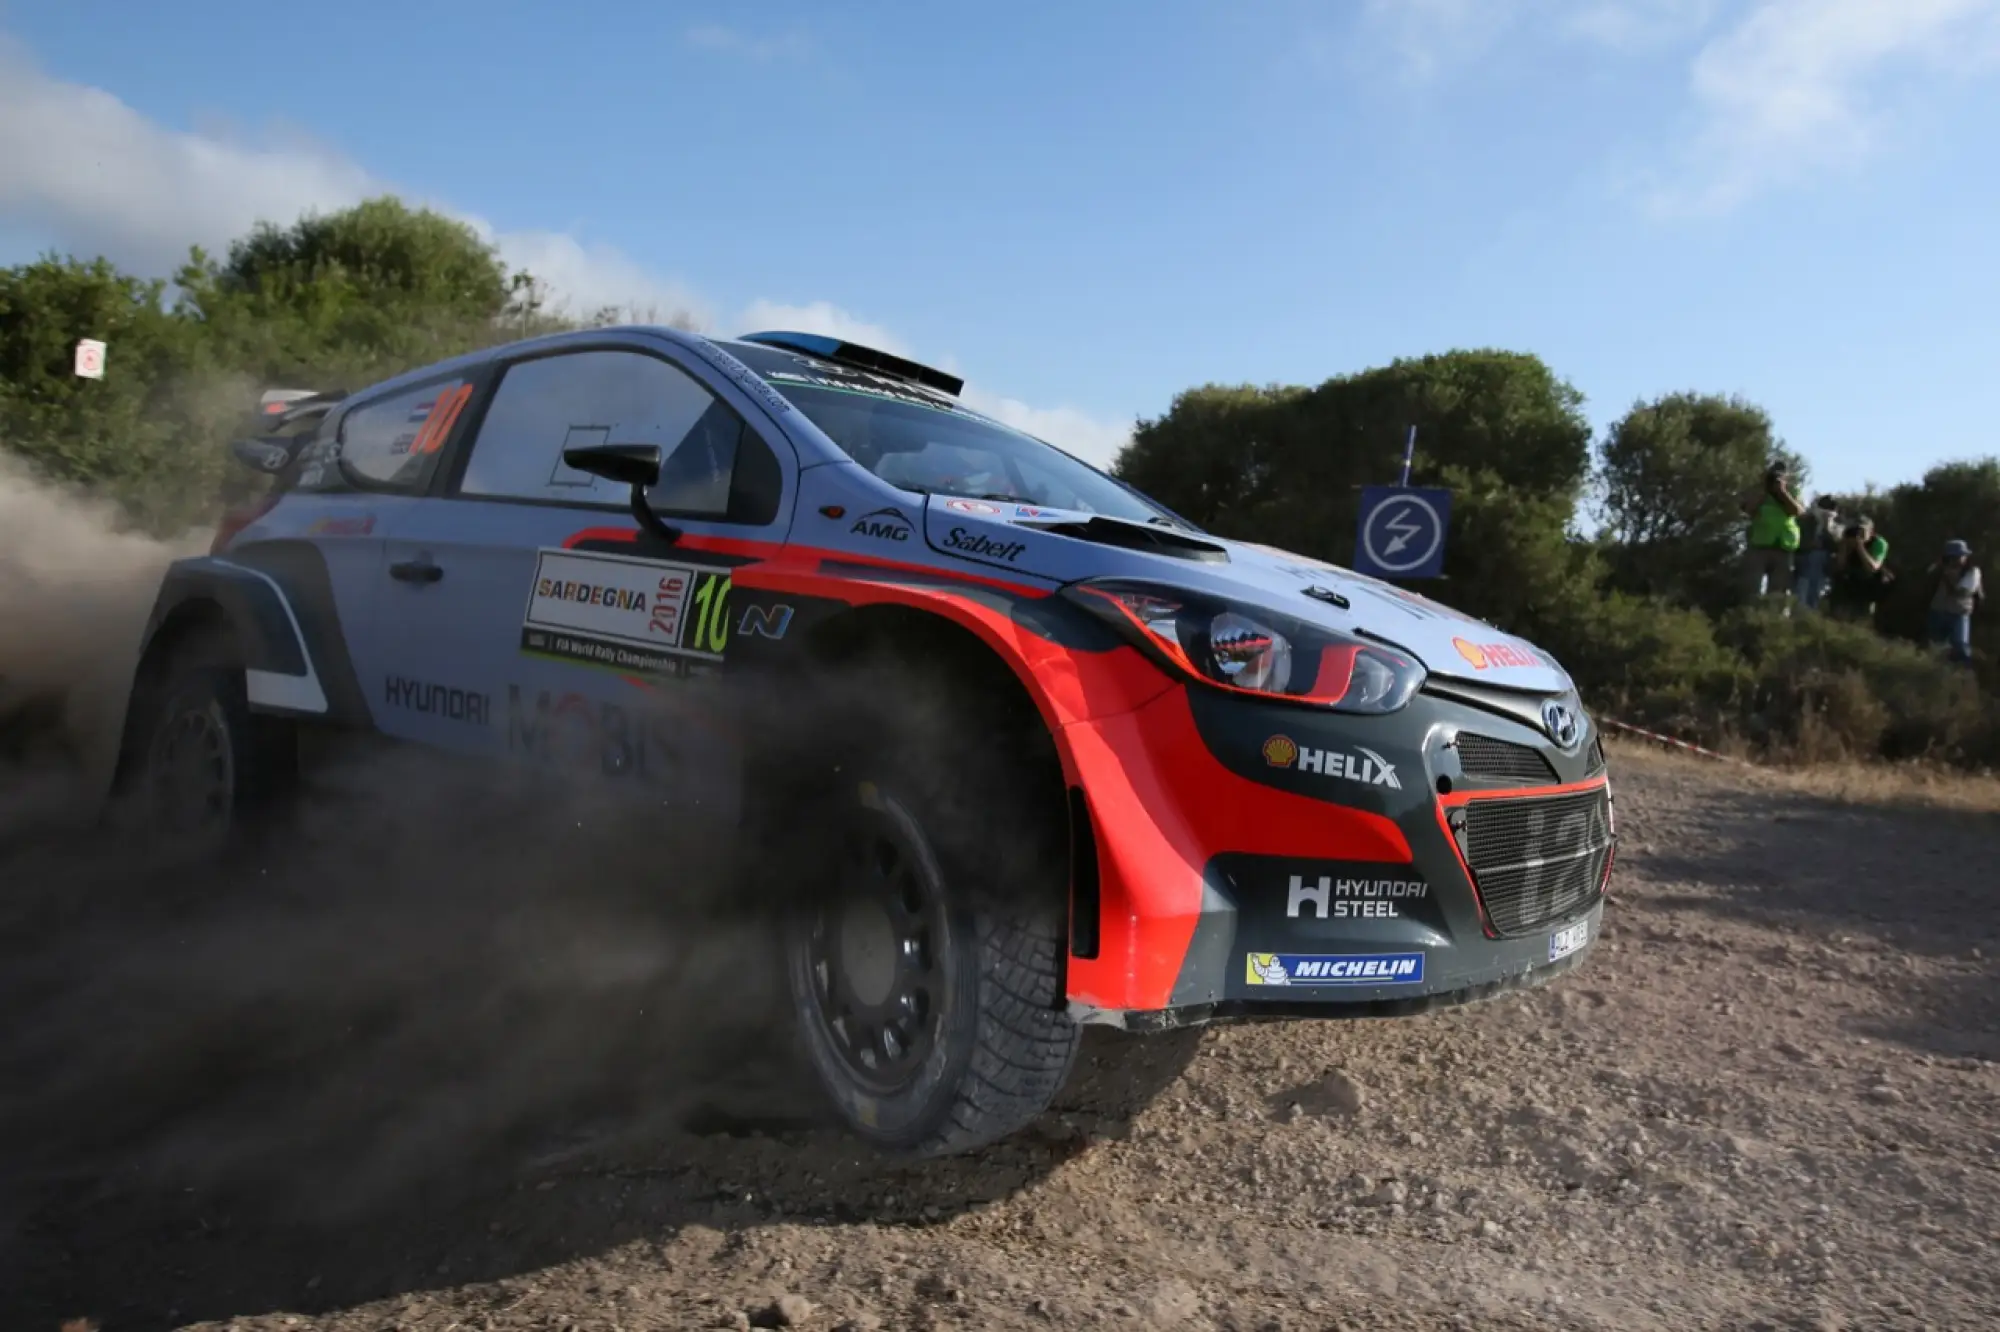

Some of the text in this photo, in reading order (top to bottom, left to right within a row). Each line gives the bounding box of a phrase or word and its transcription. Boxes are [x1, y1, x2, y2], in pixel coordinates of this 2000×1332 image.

[410, 383, 472, 457] 10
[850, 521, 909, 541] AMG
[538, 578, 647, 612] SARDEGNA
[648, 577, 684, 635] 2016
[571, 640, 595, 656] World
[595, 644, 616, 662] Rally
[1478, 643, 1541, 668] HELIX
[384, 674, 491, 727] HYUNDAI
[1297, 745, 1402, 790] HELIX
[1335, 878, 1428, 898] HYUNDAI
[1333, 900, 1399, 918] STEEL
[1295, 957, 1417, 979] MICHELIN
